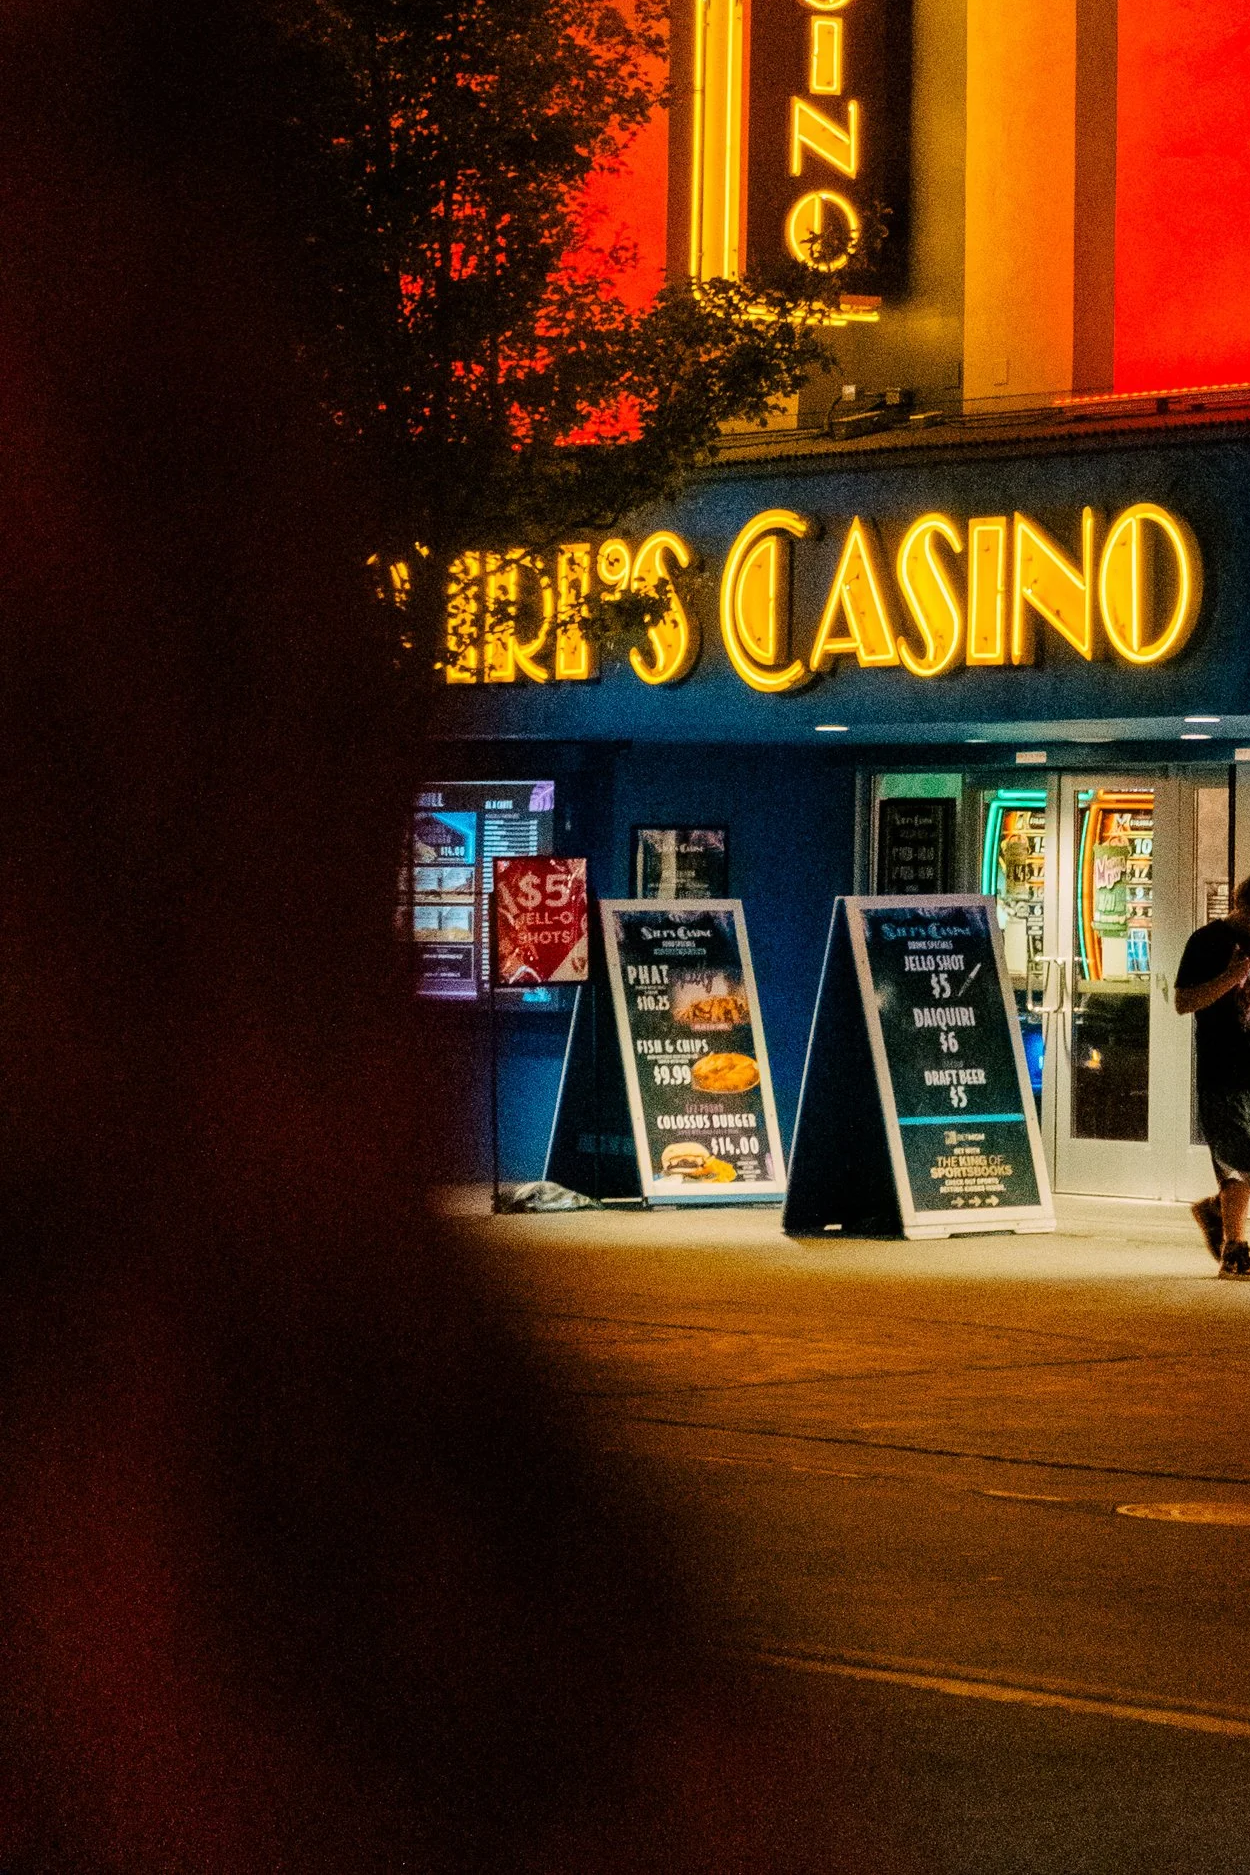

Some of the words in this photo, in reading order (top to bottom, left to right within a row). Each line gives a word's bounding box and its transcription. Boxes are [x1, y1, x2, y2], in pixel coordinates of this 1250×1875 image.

[363, 530, 692, 685] IRI'S
[719, 502, 1202, 693] CASINO
[1133, 837, 1153, 855] 10
[517, 871, 571, 909] $5
[517, 911, 574, 926] JELL-O
[518, 930, 571, 945] SHOTS
[904, 955, 935, 971] JELLO
[936, 954, 965, 971] SHOT
[627, 964, 669, 985] PHAT
[930, 973, 952, 999] $5
[636, 995, 671, 1012] $10.25
[913, 1007, 976, 1031] DAIQUIRI
[636, 1038, 663, 1054] FISH
[675, 1038, 709, 1054] CHIPS
[939, 1031, 960, 1053] $6
[653, 1064, 692, 1085] $9.99
[924, 1070, 957, 1086] DRAFT
[958, 1068, 987, 1085] BEER
[949, 1086, 969, 1108] $5
[656, 1114, 710, 1130] COLOSSUS
[711, 1113, 757, 1128] BURGER
[710, 1135, 760, 1156] $14.00
[935, 1156, 958, 1167] THE
[958, 1155, 988, 1167] KING
[988, 1154, 1005, 1166] OF
[930, 1164, 1013, 1180] SPORTSBOOKS
